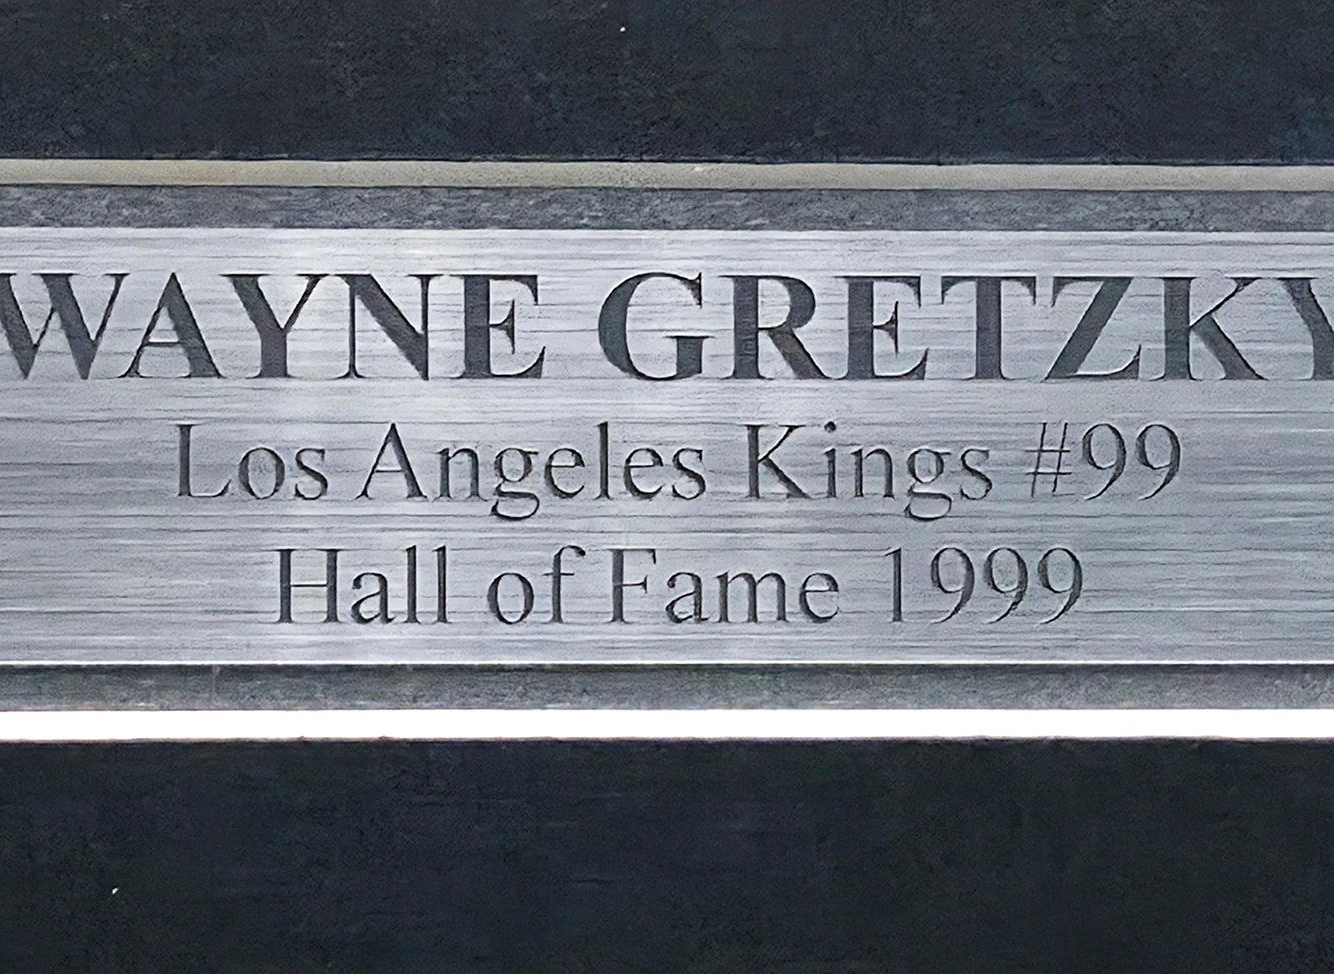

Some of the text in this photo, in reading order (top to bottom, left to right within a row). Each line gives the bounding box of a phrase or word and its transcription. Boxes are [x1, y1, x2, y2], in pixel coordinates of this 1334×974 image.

[175, 420, 1182, 522] Los Angeles Kings #99
[273, 544, 1084, 626] Hall of Fame 1999
